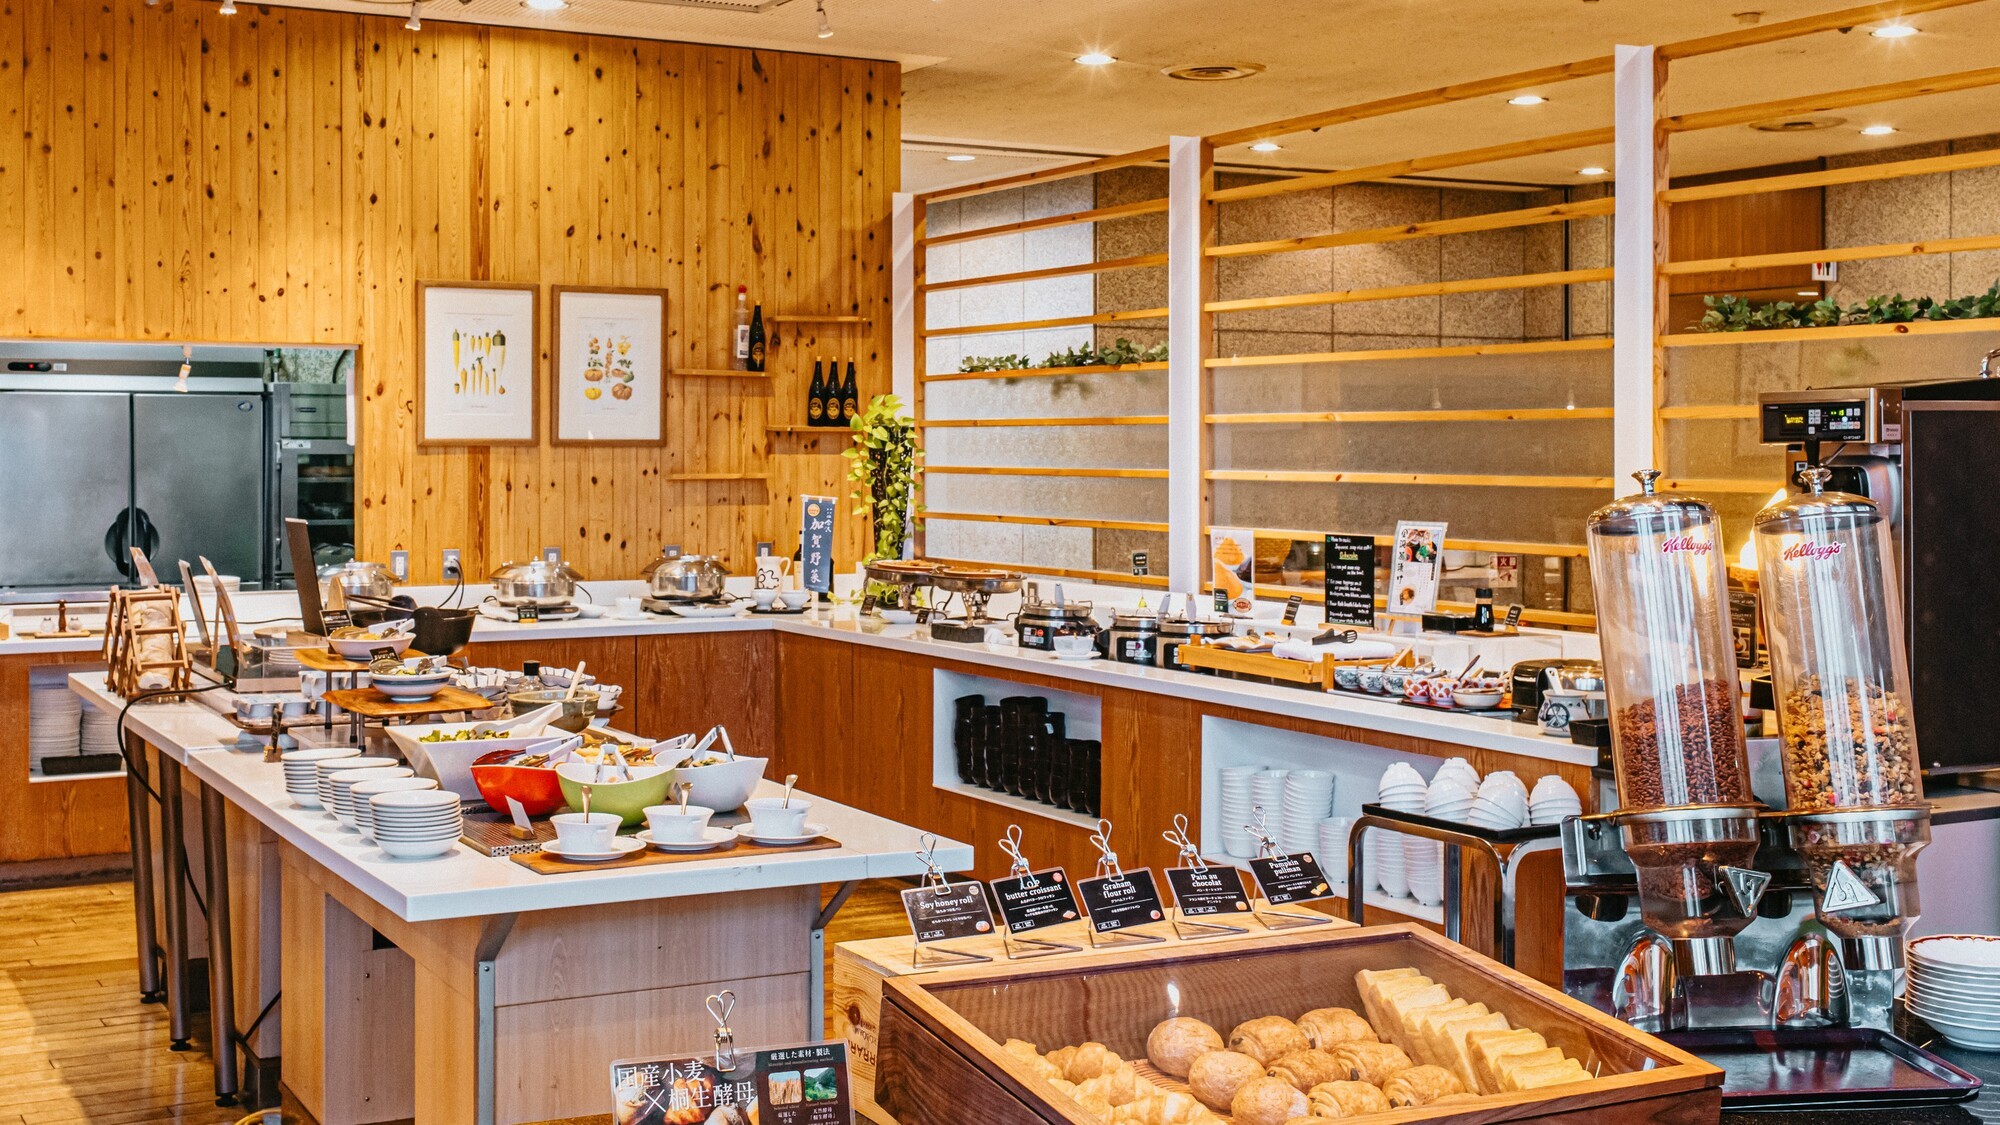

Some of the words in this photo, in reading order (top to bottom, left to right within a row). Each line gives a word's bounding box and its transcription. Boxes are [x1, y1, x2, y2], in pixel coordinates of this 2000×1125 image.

[810, 518, 825, 584] 加賀野菜
[1662, 536, 1713, 555] Kellogg's
[1784, 541, 1842, 560] Kellogg's
[1269, 860, 1299, 869] Pumpkin
[1274, 866, 1301, 876] pullman
[1005, 890, 1028, 900] butter
[1029, 884, 1062, 895] croissant
[1103, 881, 1132, 891] Graham
[1103, 890, 1121, 898] flour
[1123, 886, 1136, 895] roll
[920, 901, 934, 910] Soy
[935, 899, 958, 907] honey
[959, 896, 973, 904] roll
[616, 1060, 706, 1090] 国産小麦
